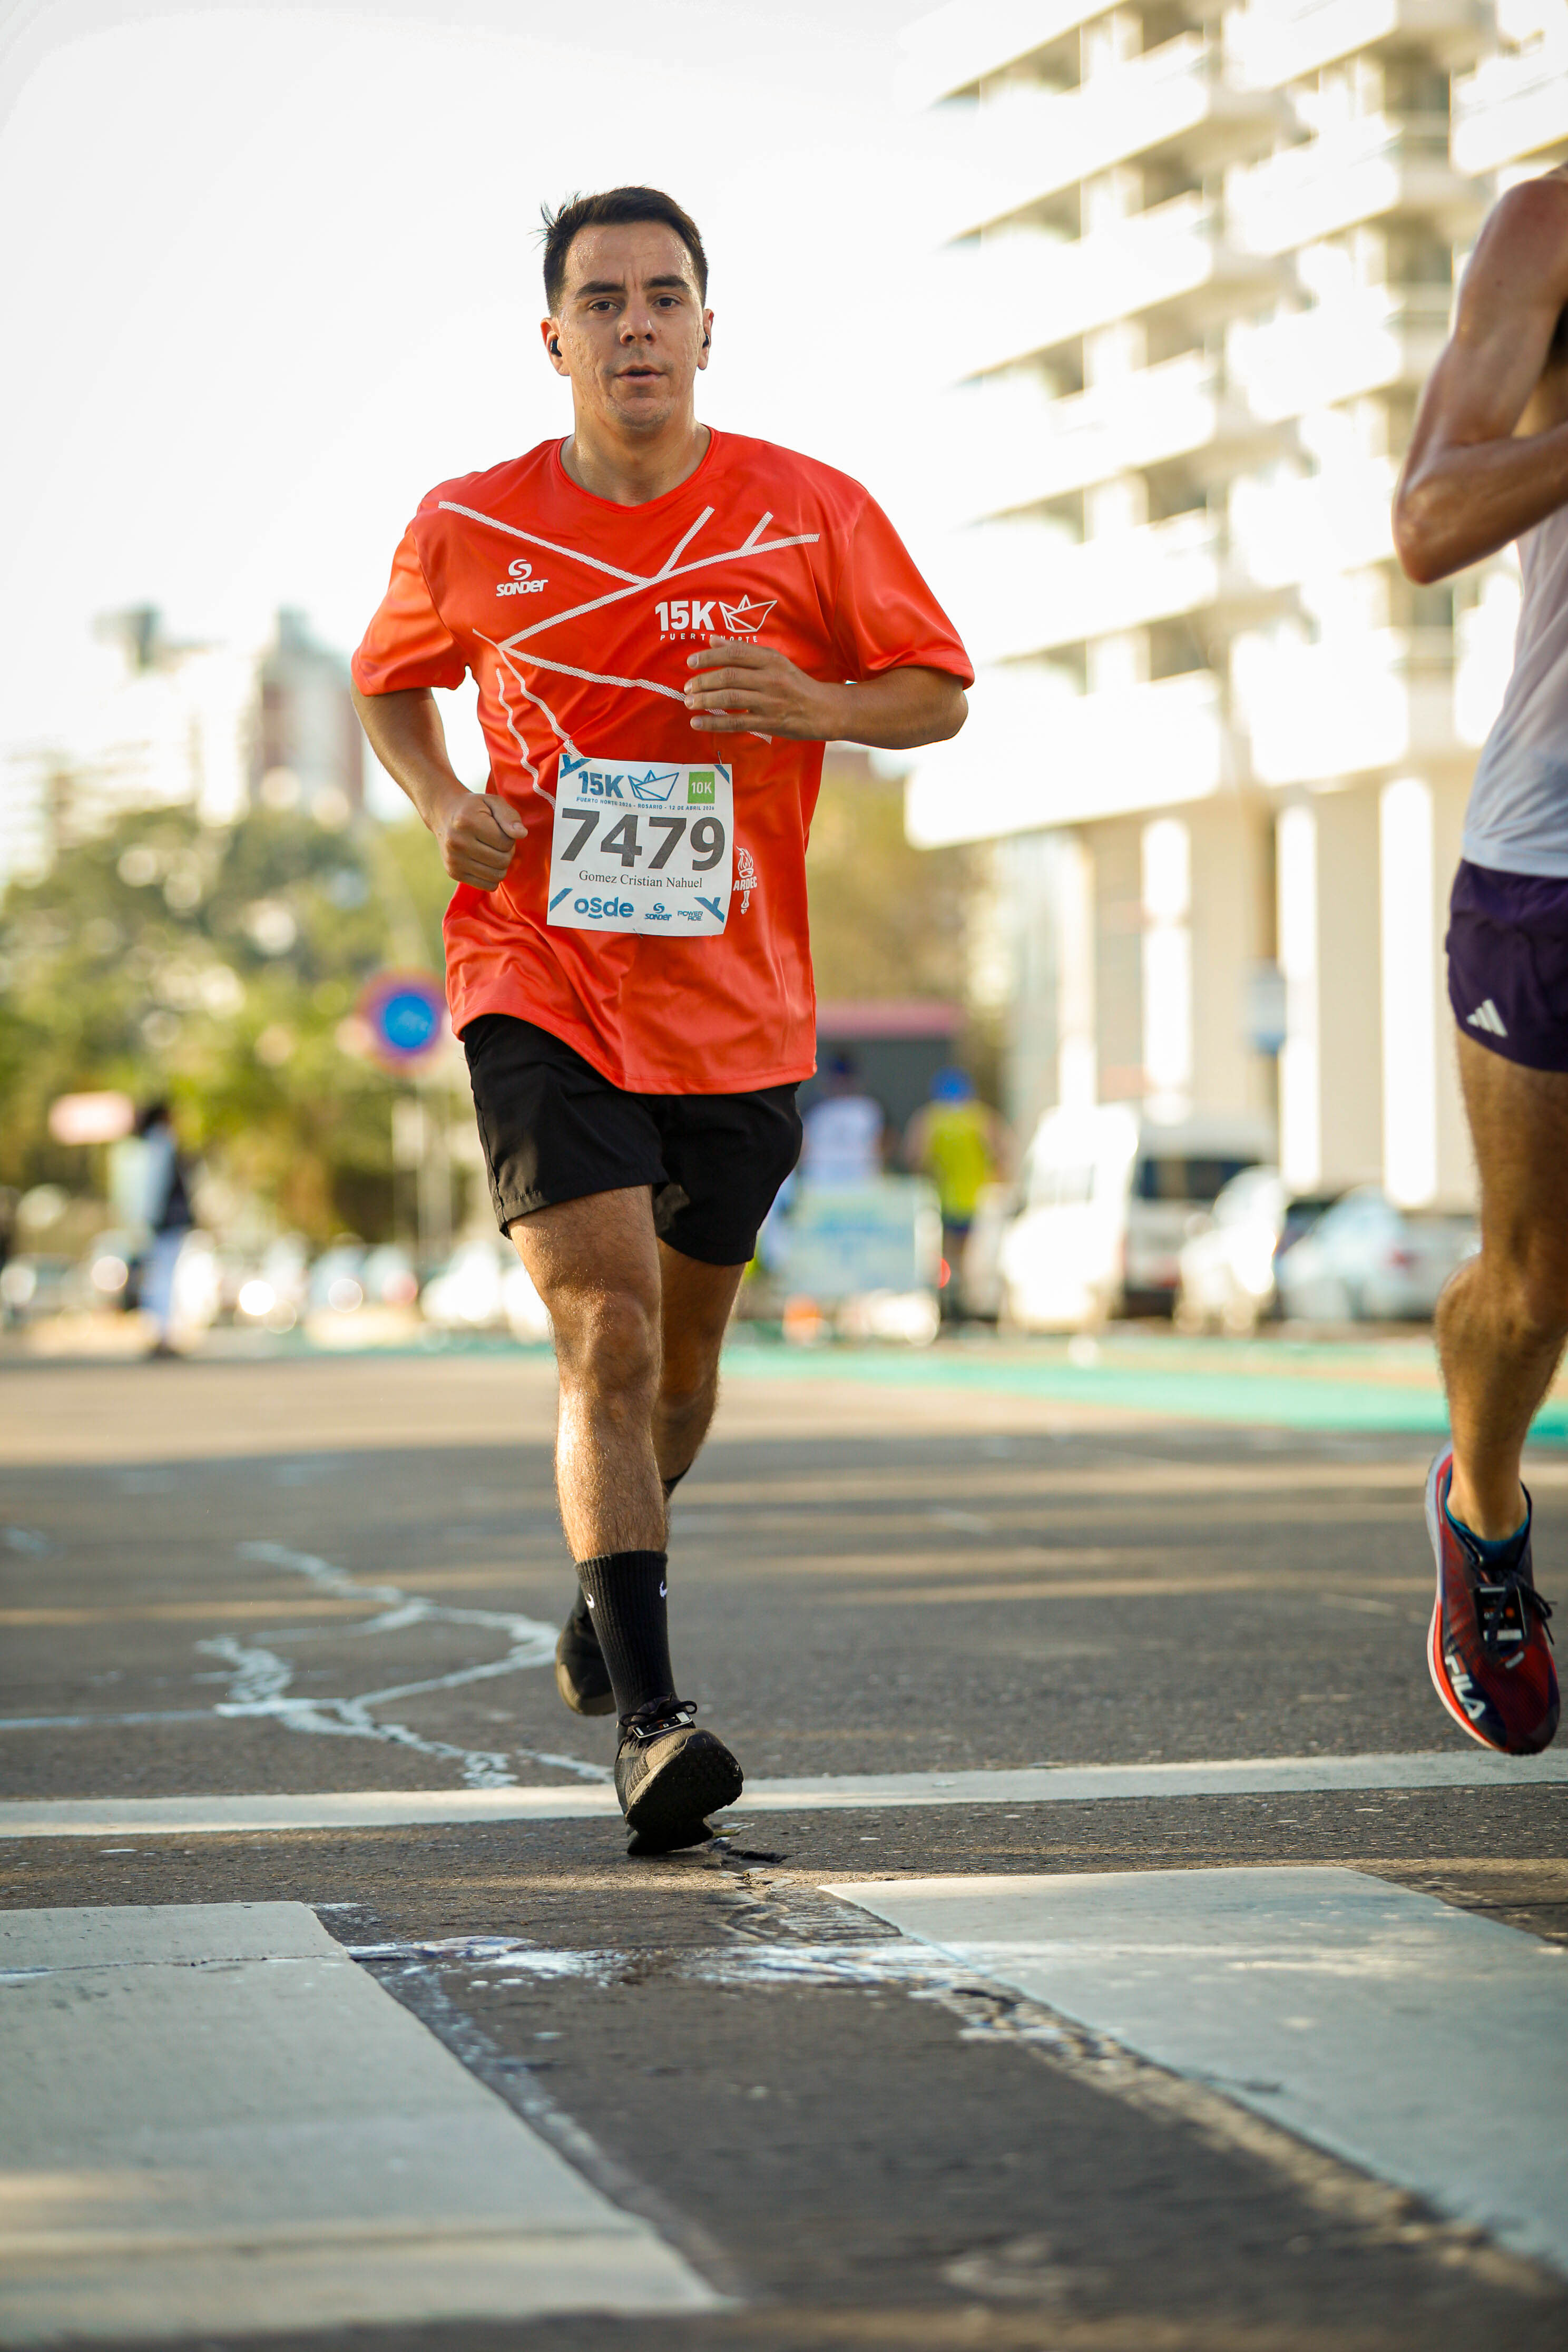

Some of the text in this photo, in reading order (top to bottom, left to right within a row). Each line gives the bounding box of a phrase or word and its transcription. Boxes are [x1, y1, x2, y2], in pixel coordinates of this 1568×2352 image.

[655, 600, 717, 631] 15K
[578, 771, 624, 798] 15K
[691, 782, 712, 794] 10K
[560, 808, 726, 871] 7479
[579, 870, 702, 888] Gomez Cristian Nahuel
[733, 876, 758, 891] ARDEC
[574, 897, 634, 918] osde
[1445, 1654, 1486, 1720] FILA
